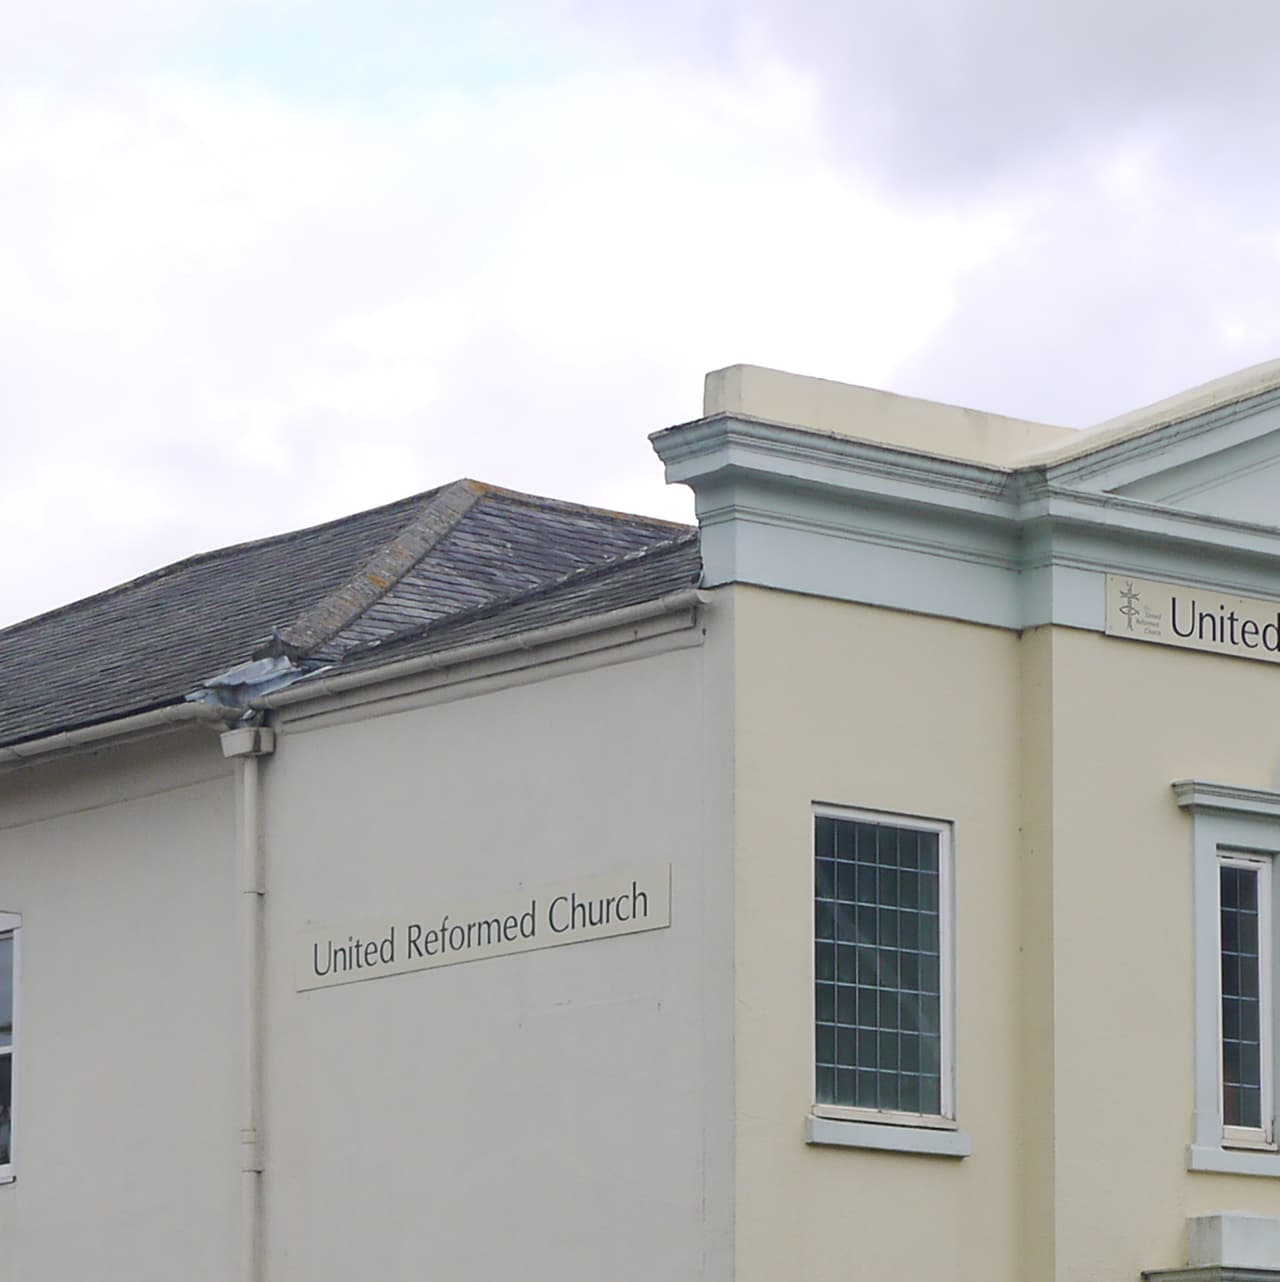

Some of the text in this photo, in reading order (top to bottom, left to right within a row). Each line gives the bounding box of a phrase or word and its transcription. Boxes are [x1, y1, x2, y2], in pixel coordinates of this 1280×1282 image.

[312, 880, 649, 977] United Reformed Church
